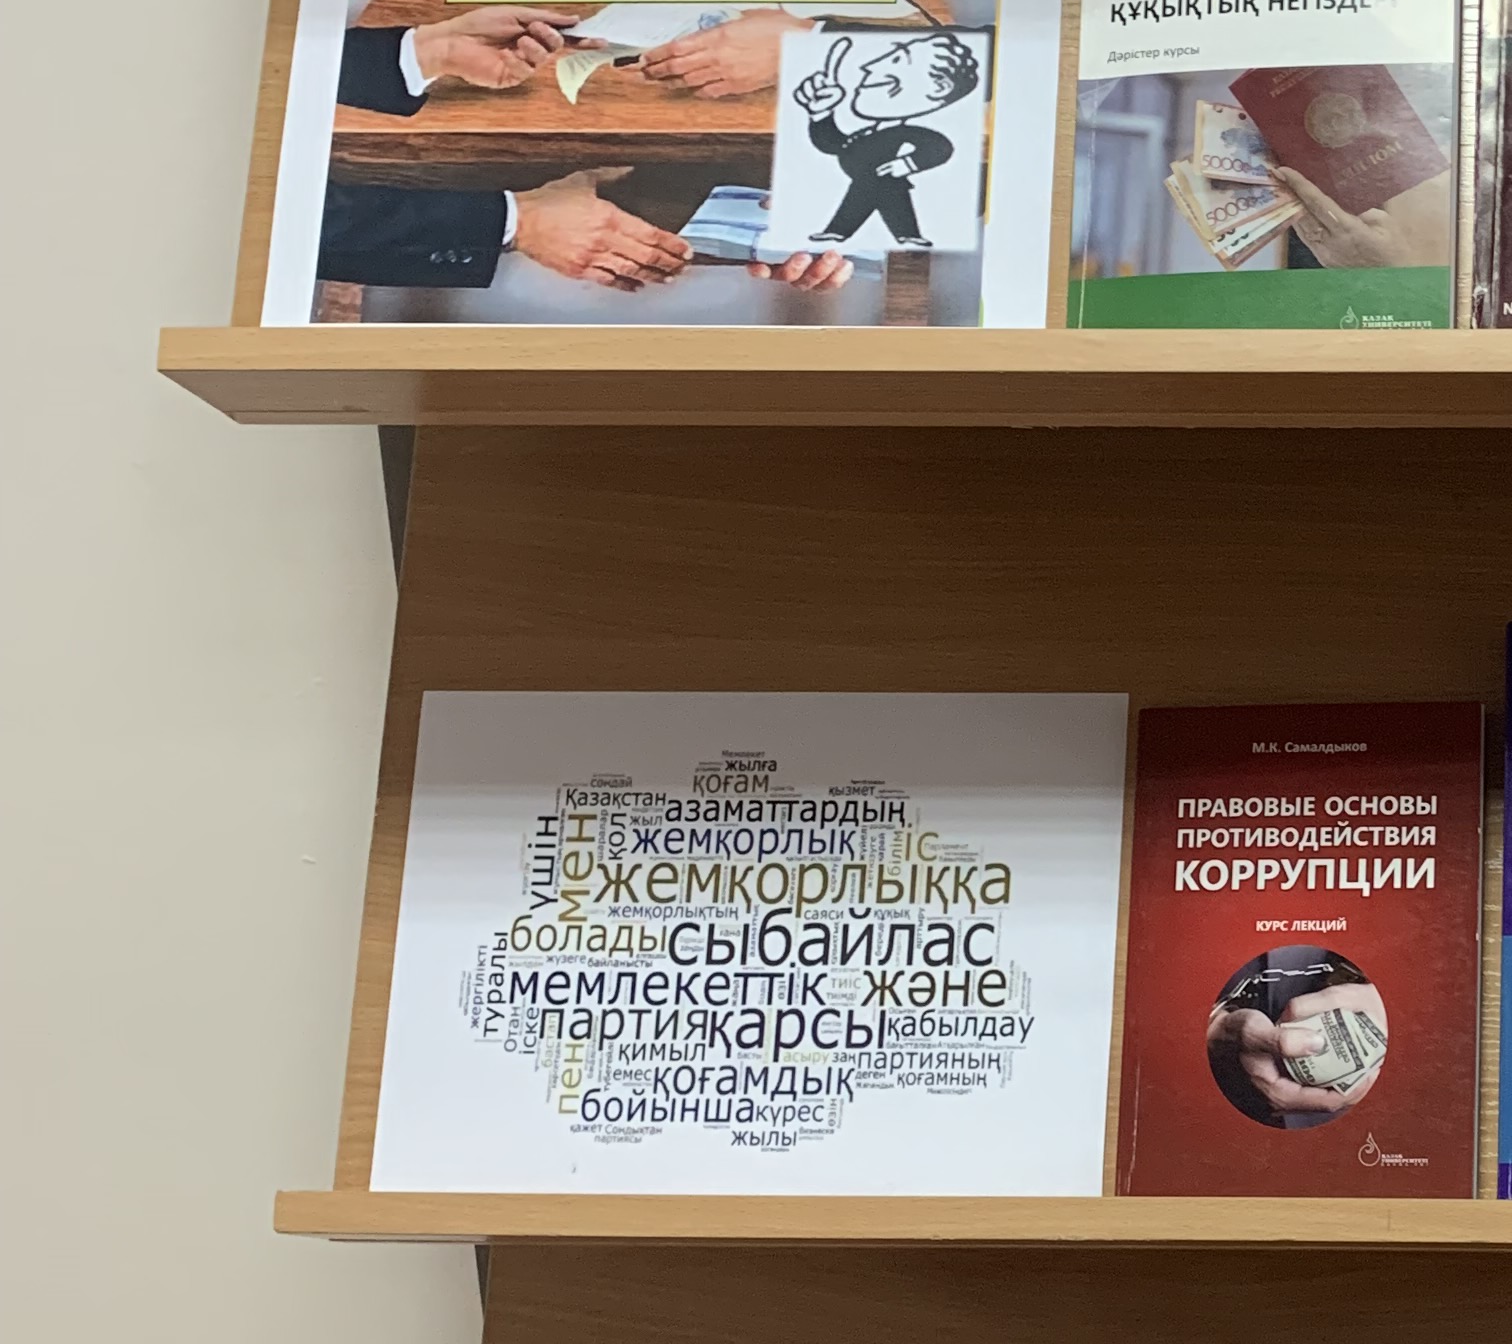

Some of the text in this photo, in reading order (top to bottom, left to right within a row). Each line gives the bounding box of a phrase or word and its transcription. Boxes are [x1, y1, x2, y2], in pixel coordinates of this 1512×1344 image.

[1107, 45, 1200, 64] Дәрістер курсы
[1252, 742, 1281, 753] М.К.
[724, 757, 778, 773] жылға
[565, 788, 666, 810] Қазақстан
[828, 785, 875, 796] қызмет
[1177, 795, 1437, 818] ПРАВОВЫЕ ОСНОВЫ
[665, 798, 906, 828] азаматтардың
[608, 813, 627, 860] қол
[630, 827, 857, 863] жемқорлық
[1177, 821, 1436, 851] ПРОТИВОДЕЙСТВИЯ
[528, 815, 558, 910] үшін
[558, 814, 598, 922] мен
[1175, 858, 1436, 897] КОРРУПЦИИ
[593, 862, 1012, 919] жемқорлыққа
[607, 905, 738, 920] жемқорлықтың
[1255, 918, 1347, 933] КУРС ЛЕКЦИЙ
[511, 914, 667, 958] болады
[668, 907, 995, 967] сыбайлас
[509, 962, 828, 1006] мемлекеттік
[860, 969, 1006, 1006] және
[504, 1006, 520, 1052] Отан
[519, 1008, 540, 1054] іске
[888, 1009, 1034, 1043] қабылдау
[619, 1044, 706, 1064] қимыл
[858, 1050, 1000, 1074] партияның
[558, 1042, 584, 1114] пен
[652, 1065, 855, 1102] қоғамдық
[897, 1071, 987, 1088] қоғамның
[756, 1104, 824, 1126] күрес
[731, 1129, 797, 1147] жылы
